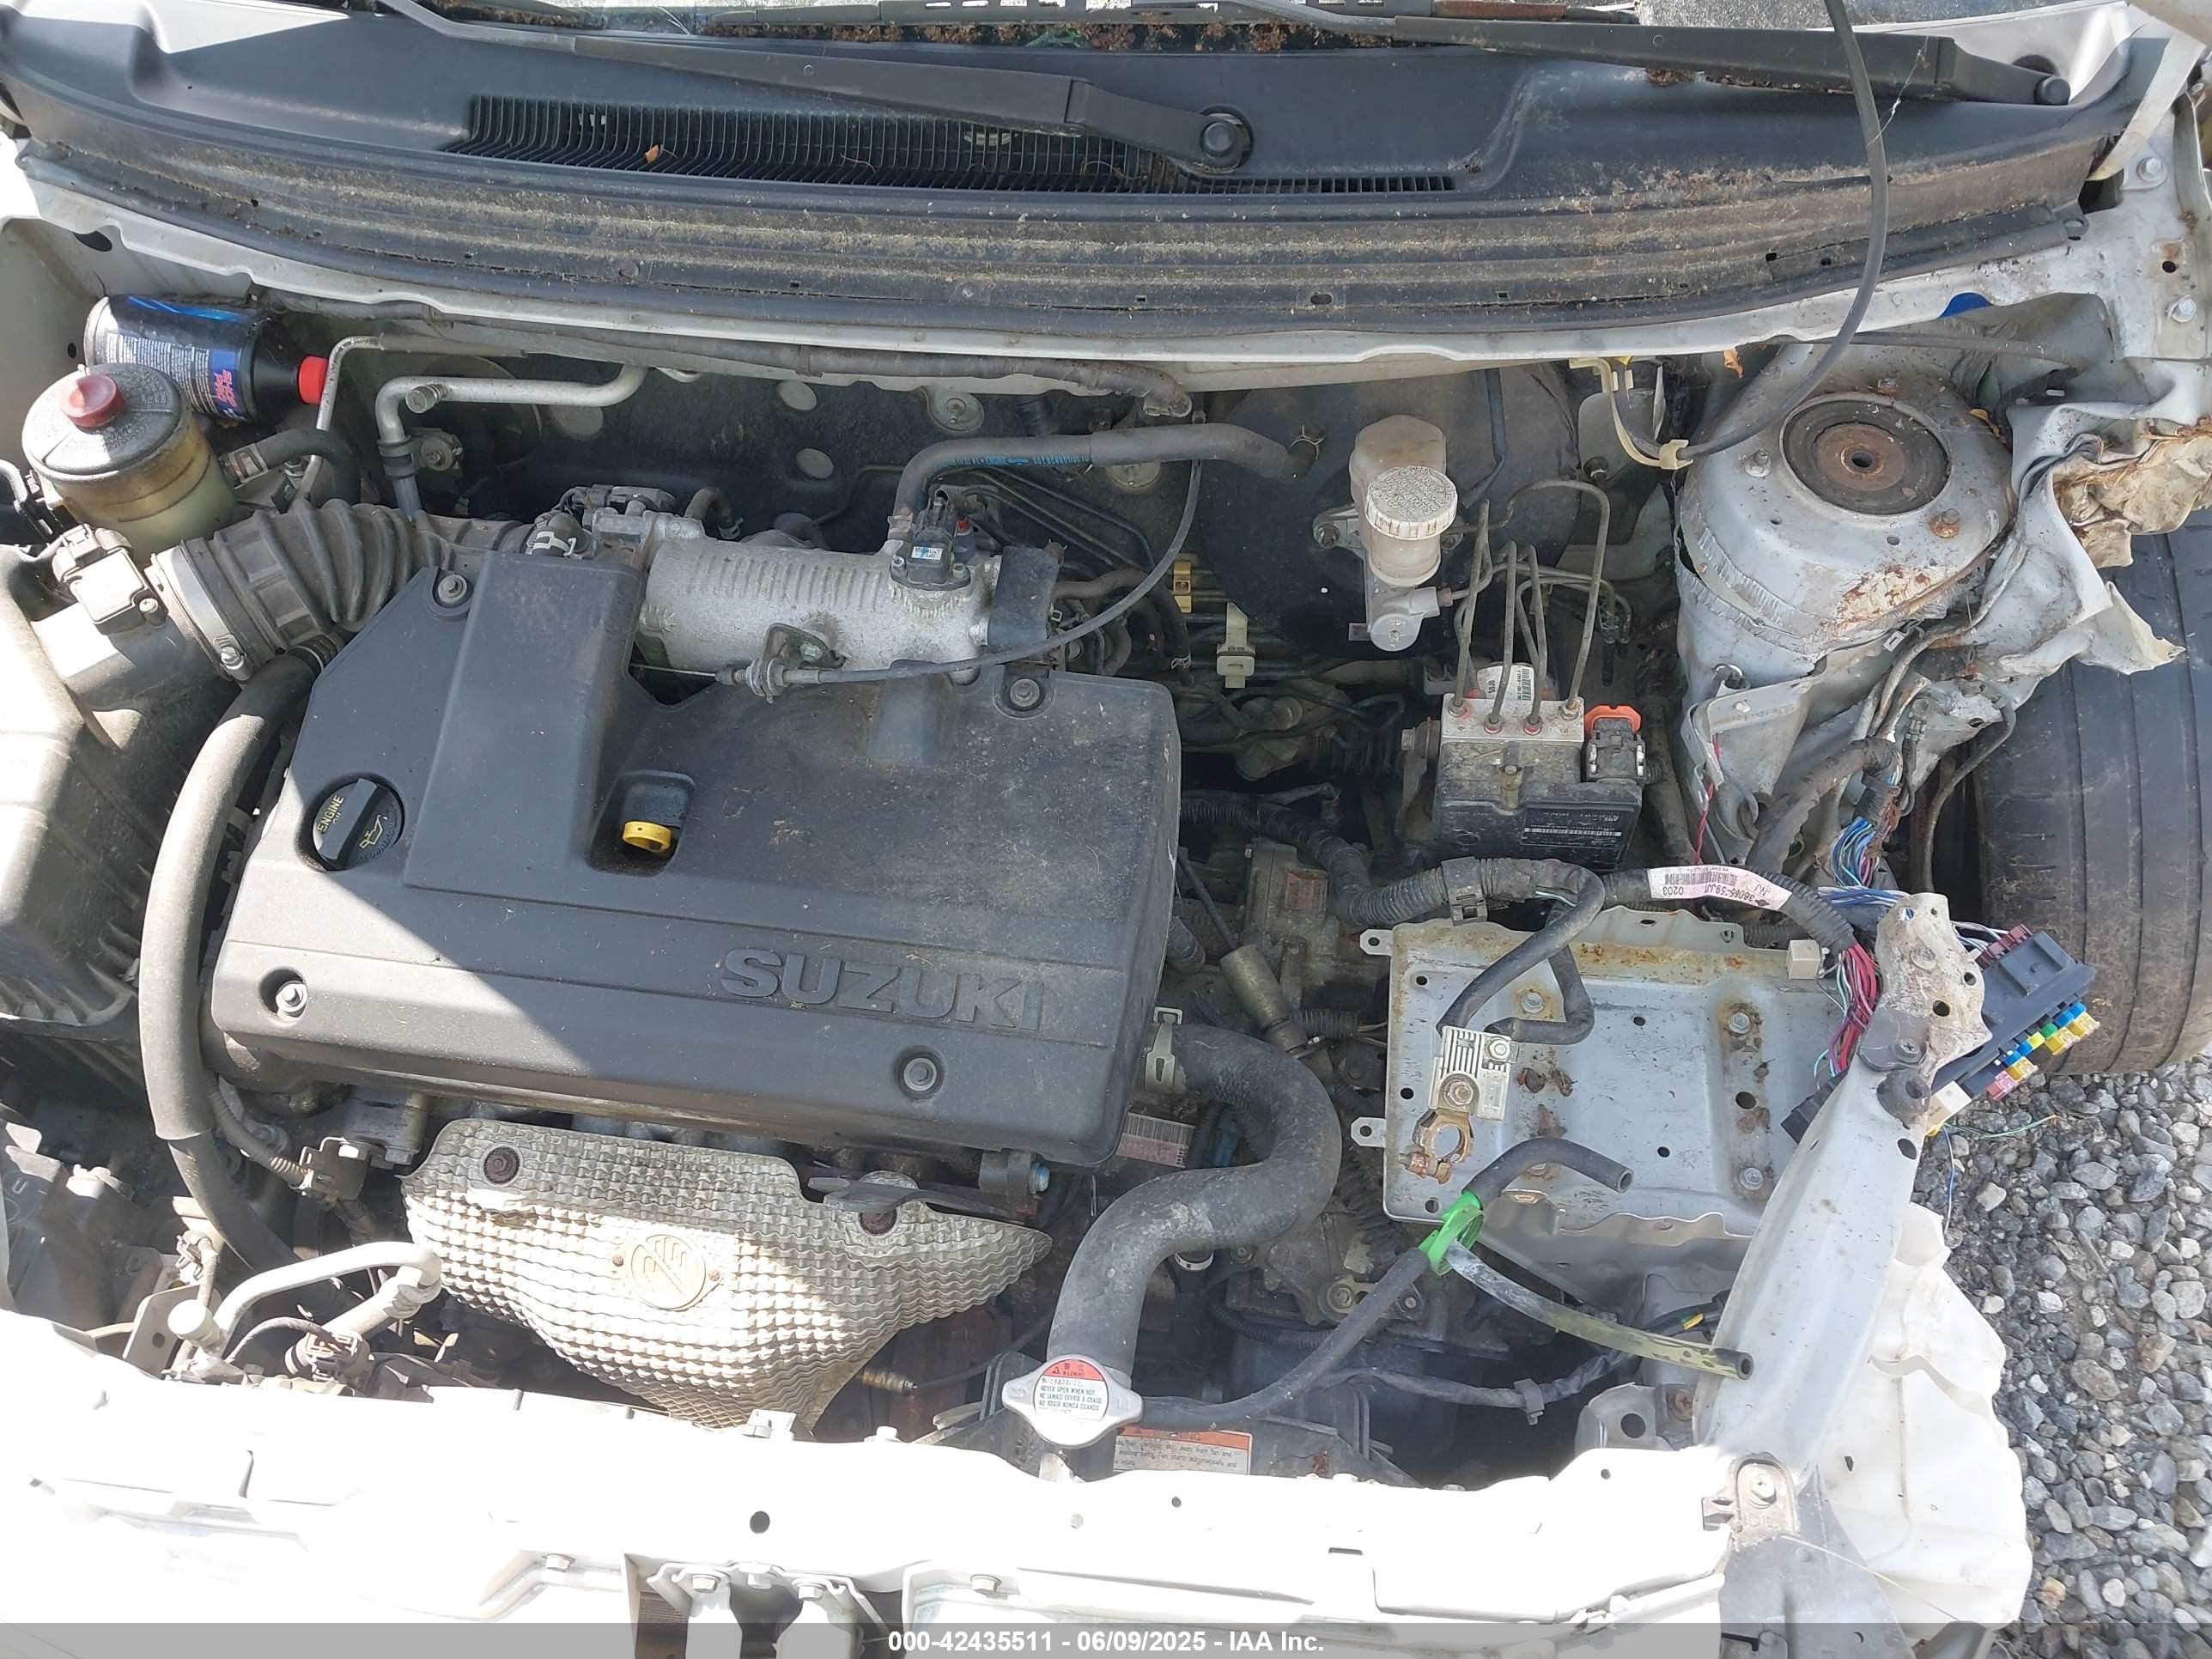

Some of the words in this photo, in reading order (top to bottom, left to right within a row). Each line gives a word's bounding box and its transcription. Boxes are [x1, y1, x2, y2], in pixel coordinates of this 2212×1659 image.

[316, 793, 344, 832] ENGINE
[1662, 885, 1684, 896] 0203
[720, 947, 1044, 1031] SUZUKI
